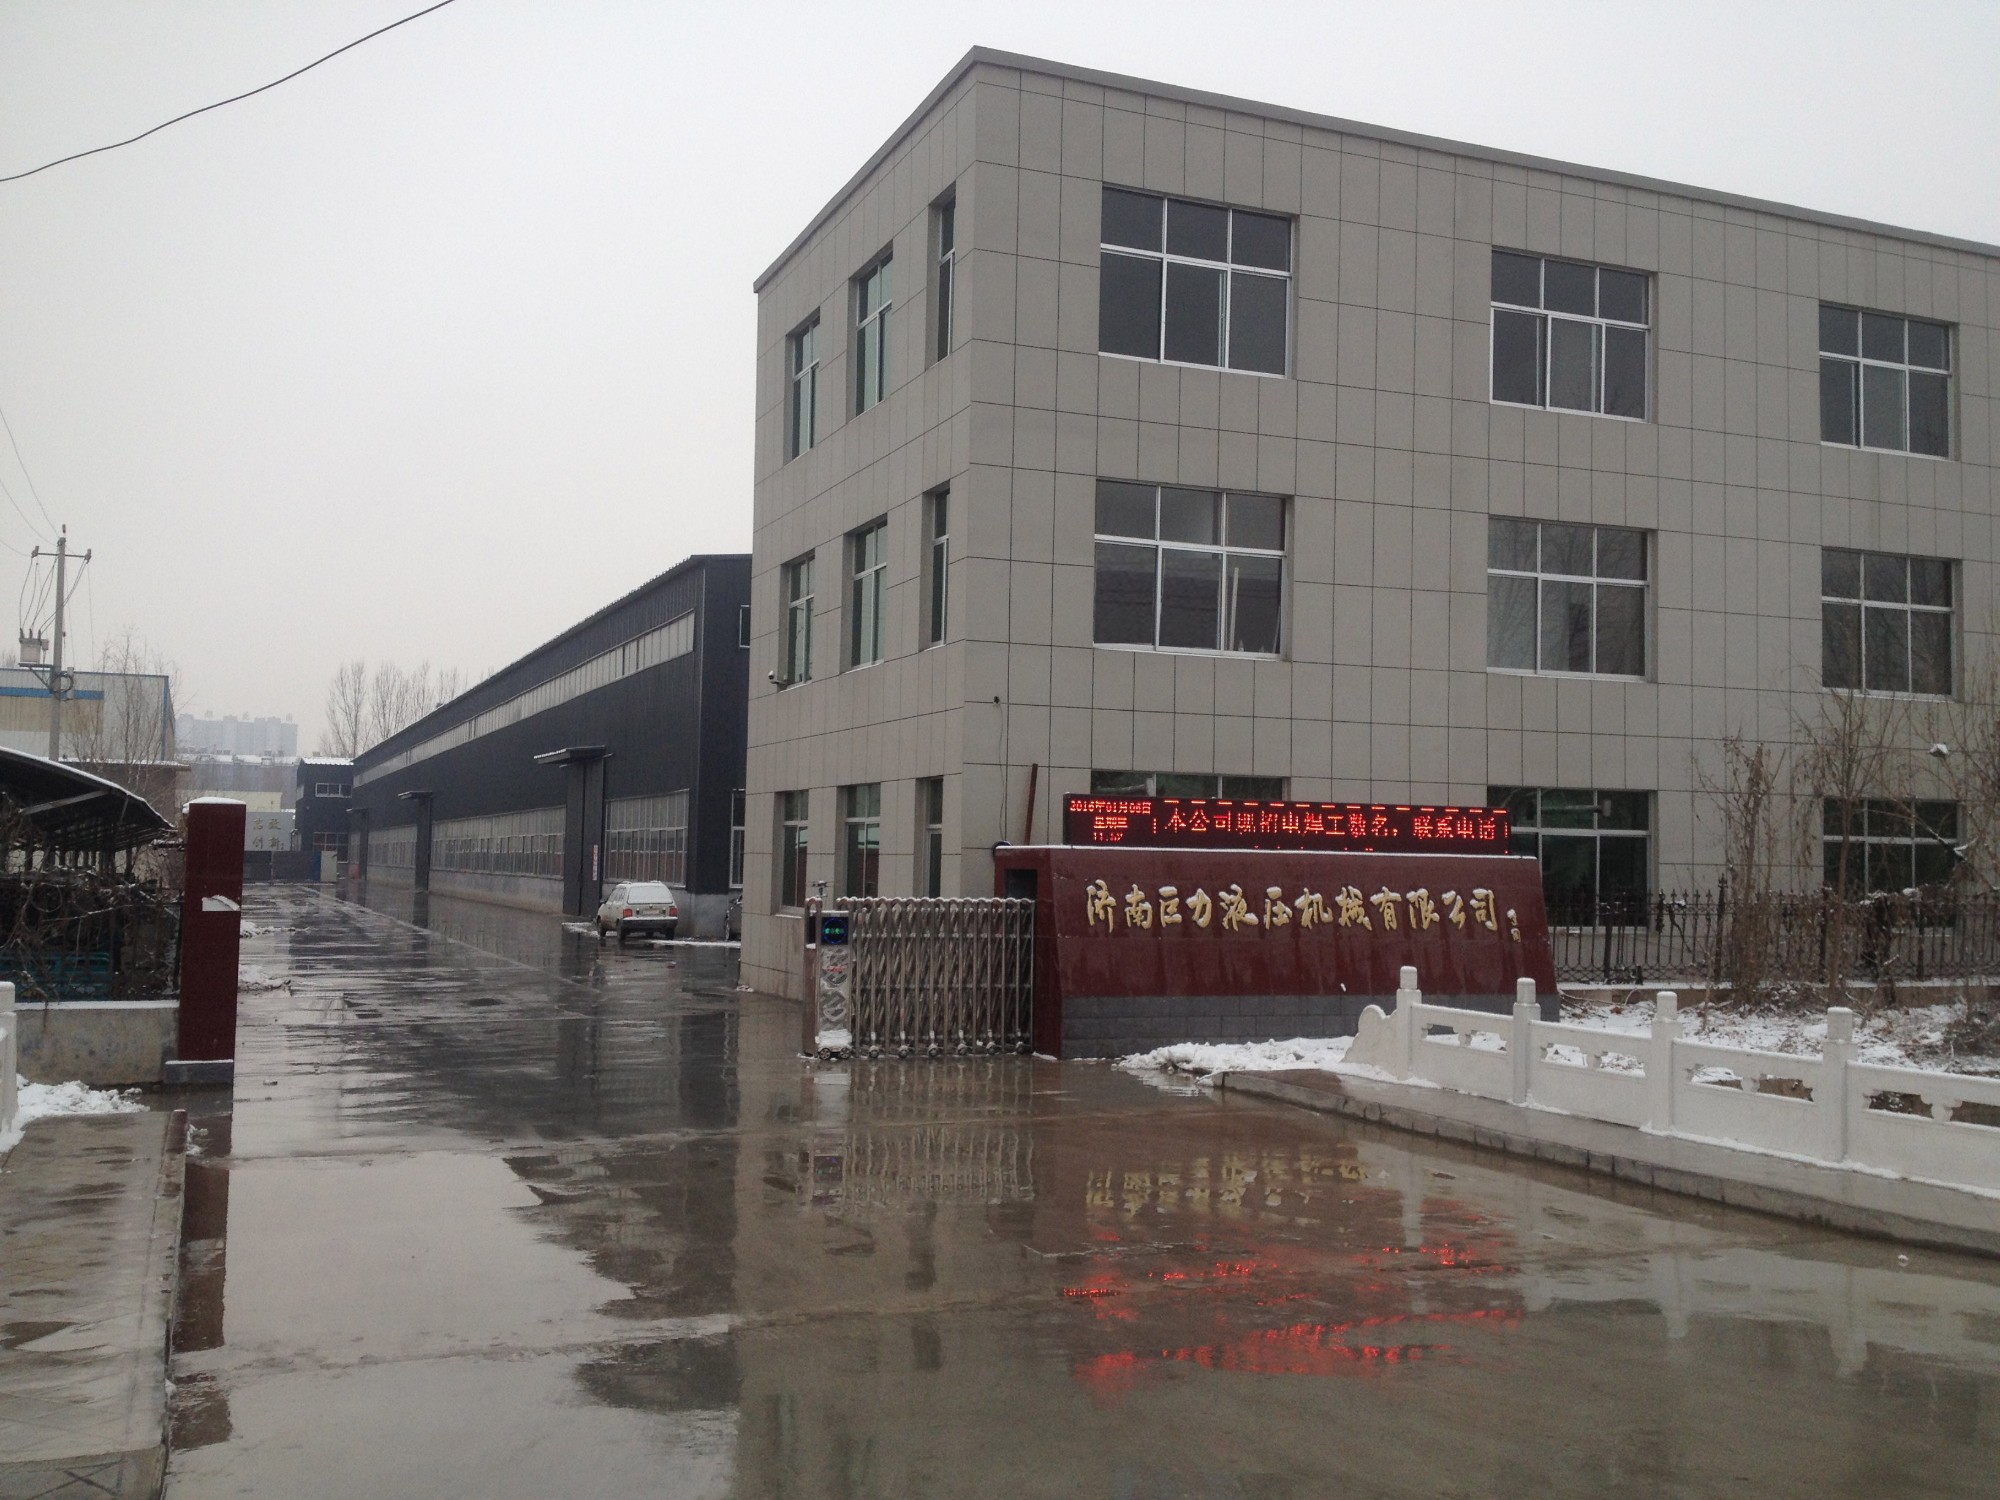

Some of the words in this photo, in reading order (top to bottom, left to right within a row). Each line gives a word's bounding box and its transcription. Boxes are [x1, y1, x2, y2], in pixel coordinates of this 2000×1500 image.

[1086, 879, 1497, 933] 济南巨力液压机械有限公司
